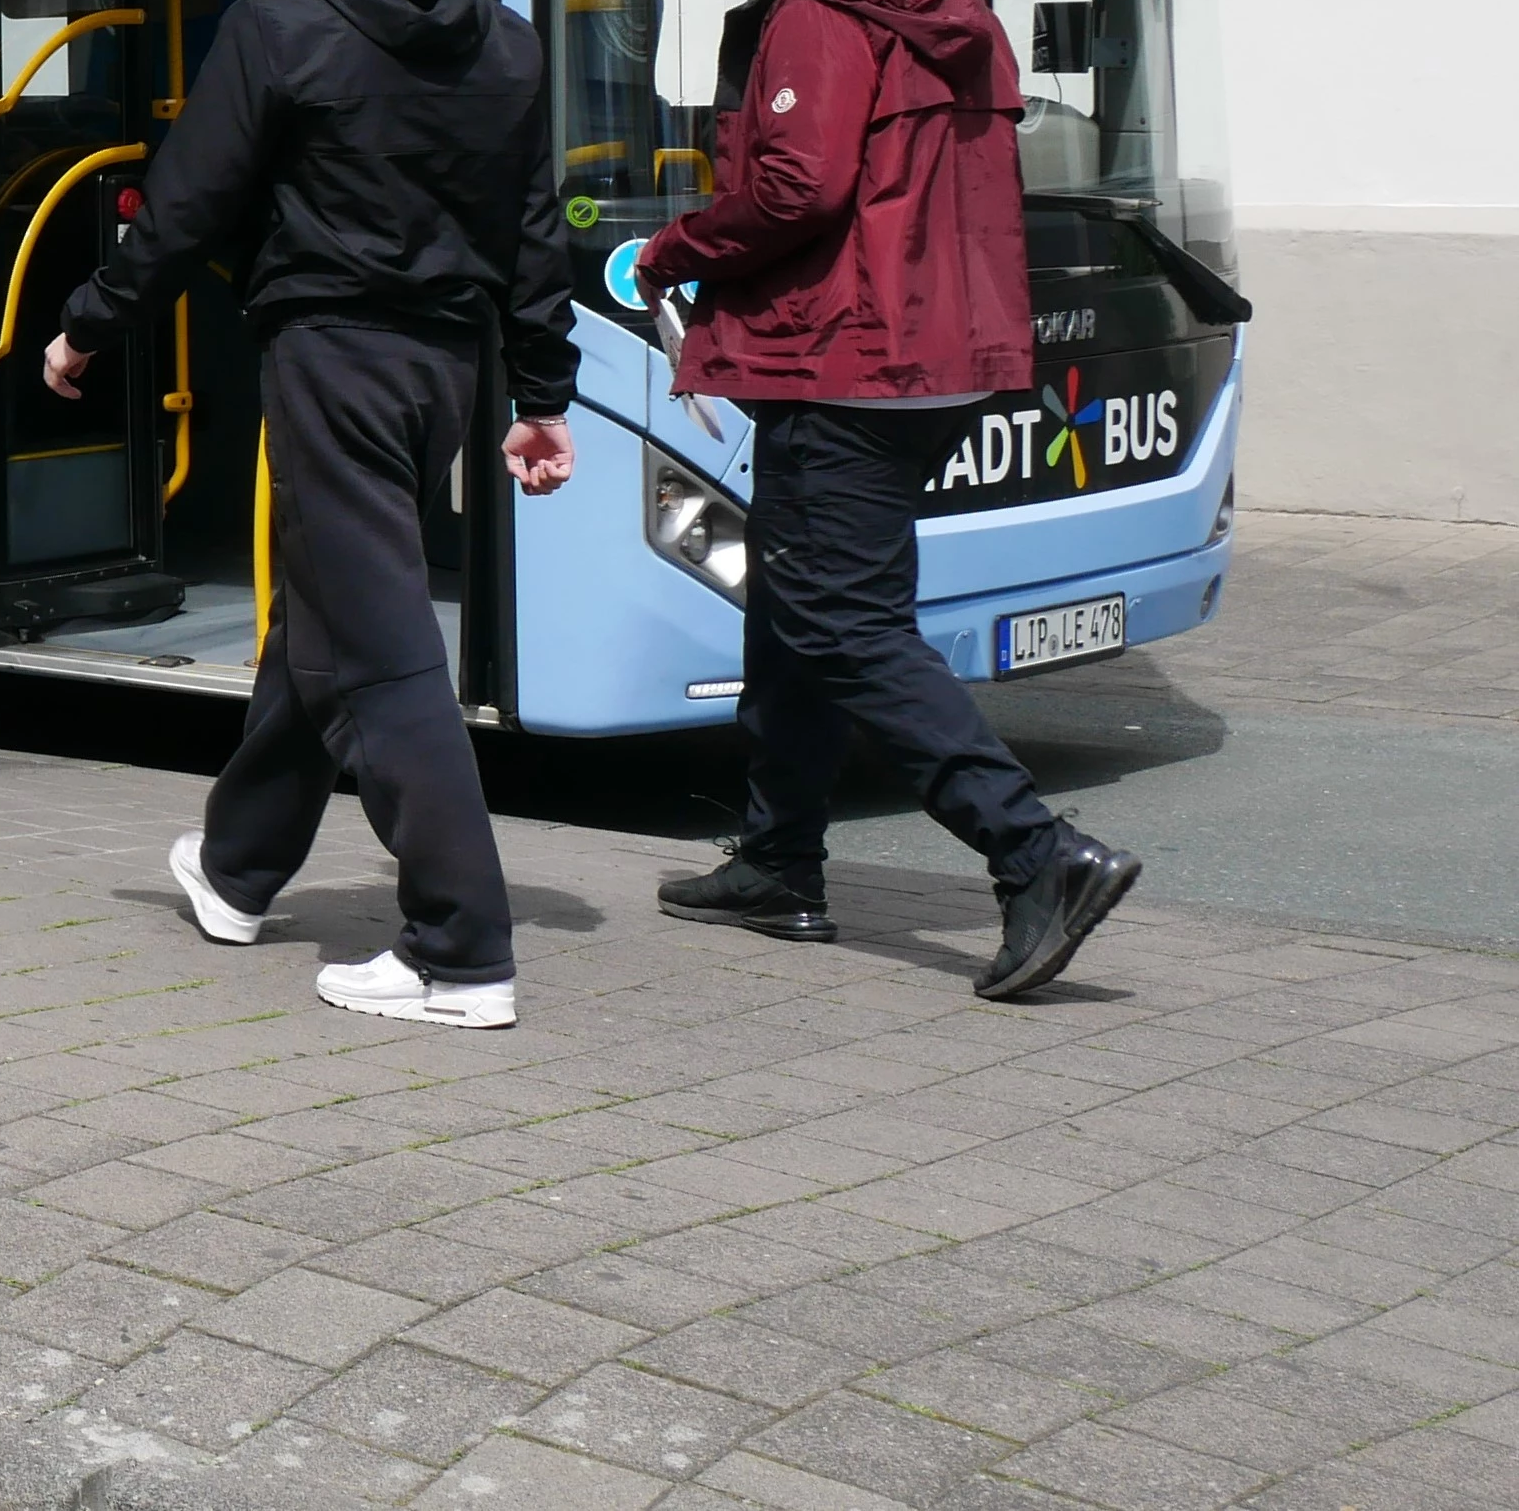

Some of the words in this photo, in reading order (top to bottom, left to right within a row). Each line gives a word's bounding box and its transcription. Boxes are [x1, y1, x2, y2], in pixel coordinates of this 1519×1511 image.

[1029, 308, 1096, 344] TOKAR
[925, 409, 1042, 491] ADT
[1105, 389, 1179, 466] BUS
[1014, 616, 1048, 661] LIP
[1062, 609, 1085, 649] LE
[1090, 602, 1121, 645] 478
